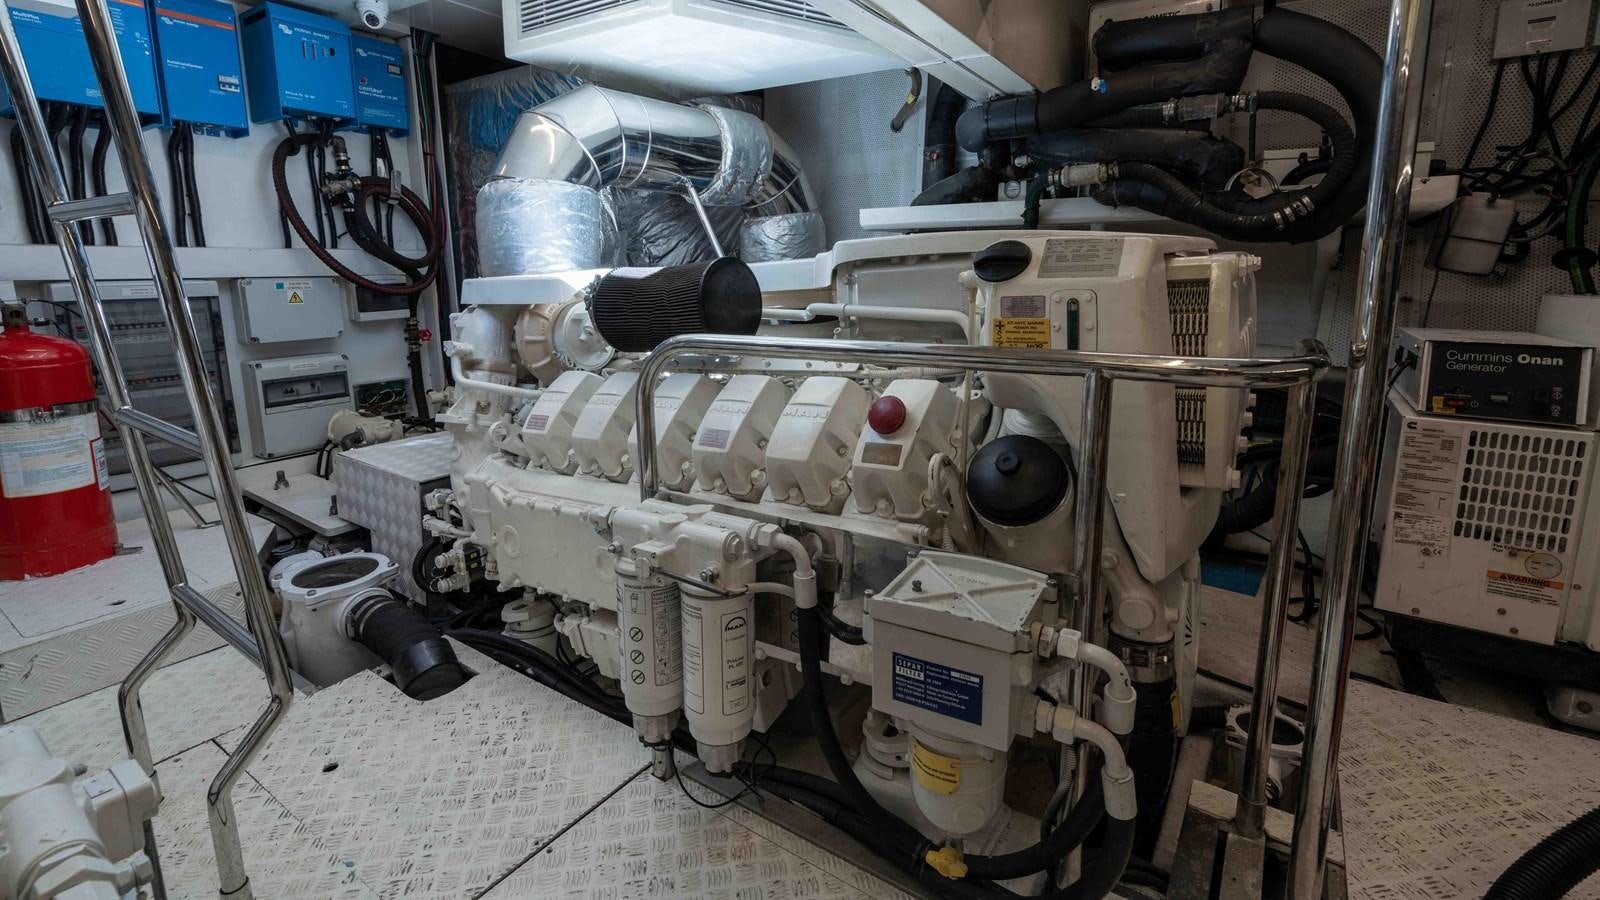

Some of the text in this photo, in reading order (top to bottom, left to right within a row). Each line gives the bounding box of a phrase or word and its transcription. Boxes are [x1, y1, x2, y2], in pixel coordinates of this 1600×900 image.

[1446, 350, 1564, 366] Cummins Onan
[1446, 360, 1507, 373] Generator
[708, 402, 751, 415] MAN
[782, 406, 831, 419] MAN
[1507, 573, 1551, 588] WARNING
[898, 659, 922, 671] SEPAR
[898, 667, 922, 678] FILTER
